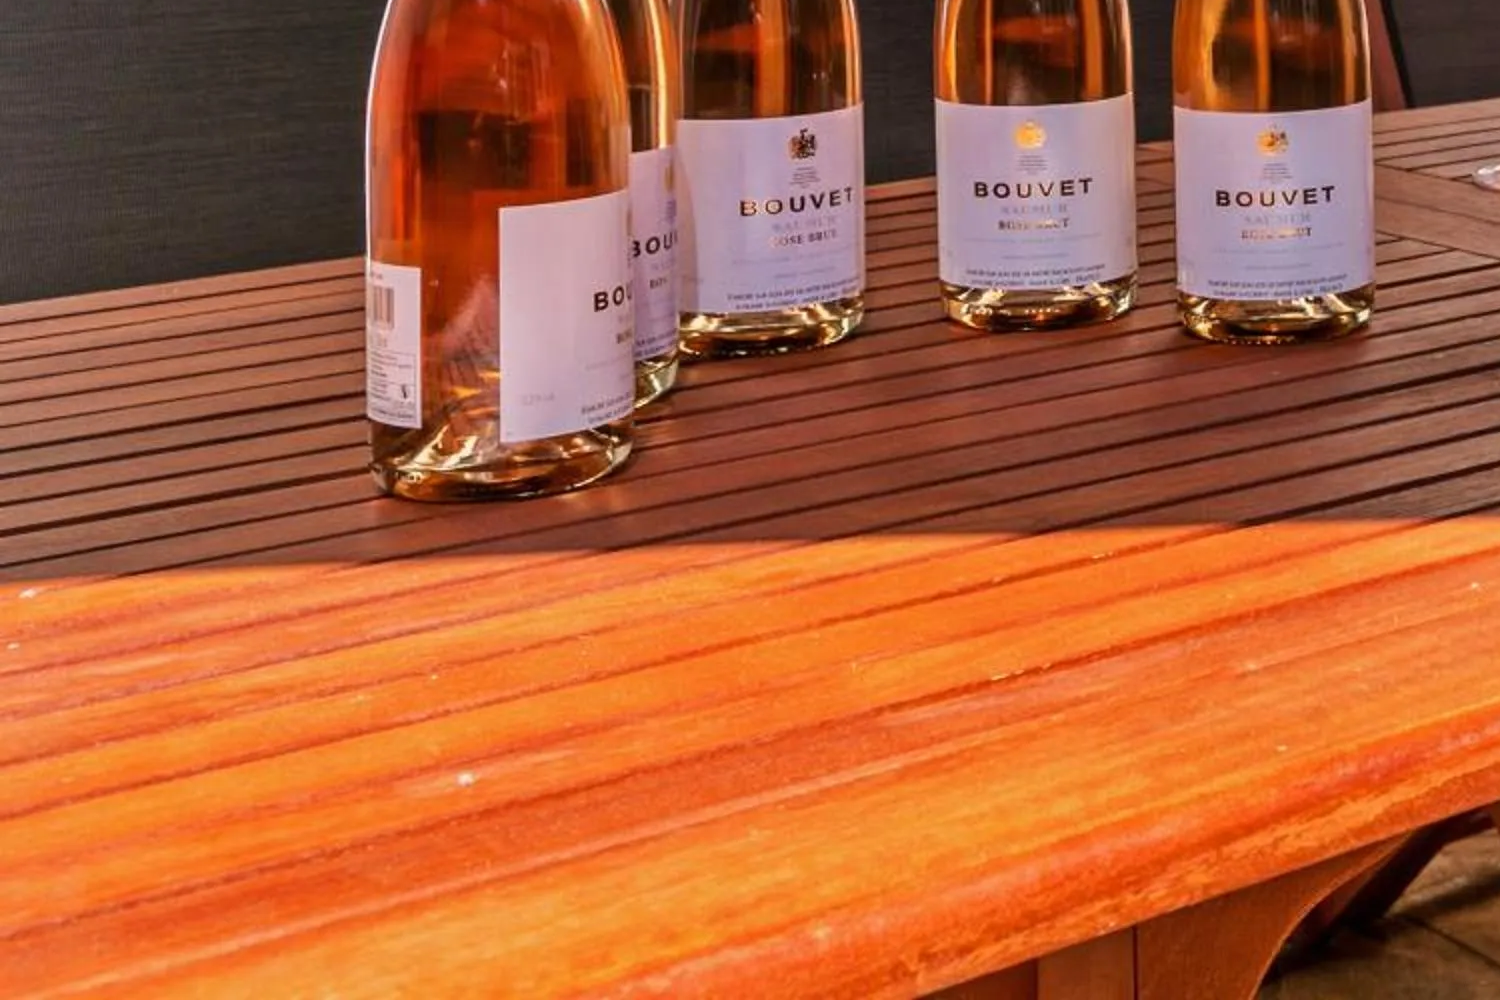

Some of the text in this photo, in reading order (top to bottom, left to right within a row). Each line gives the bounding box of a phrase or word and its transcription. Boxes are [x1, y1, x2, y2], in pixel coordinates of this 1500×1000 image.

[974, 178, 1093, 199] BOUVET
[1215, 185, 1335, 207] BOUVET
[739, 187, 853, 217] BOUVET
